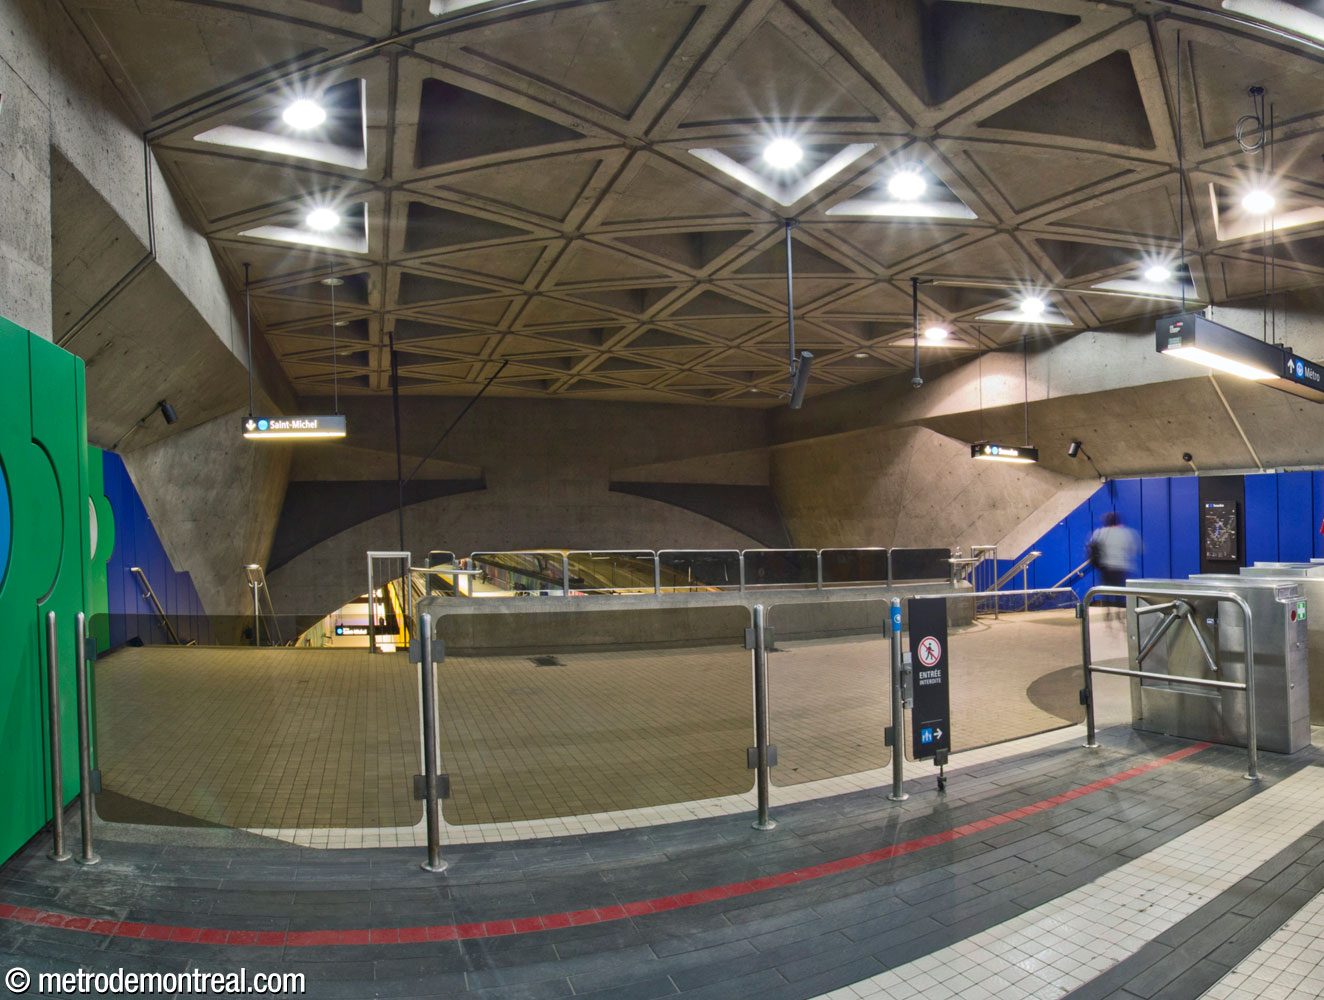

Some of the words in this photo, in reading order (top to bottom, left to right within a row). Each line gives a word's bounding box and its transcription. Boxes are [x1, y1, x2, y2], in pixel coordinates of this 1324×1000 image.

[1305, 366, 1320, 382] Métro
[269, 420, 318, 429] Saint-Michel
[919, 669, 941, 679] ENTRÉE
